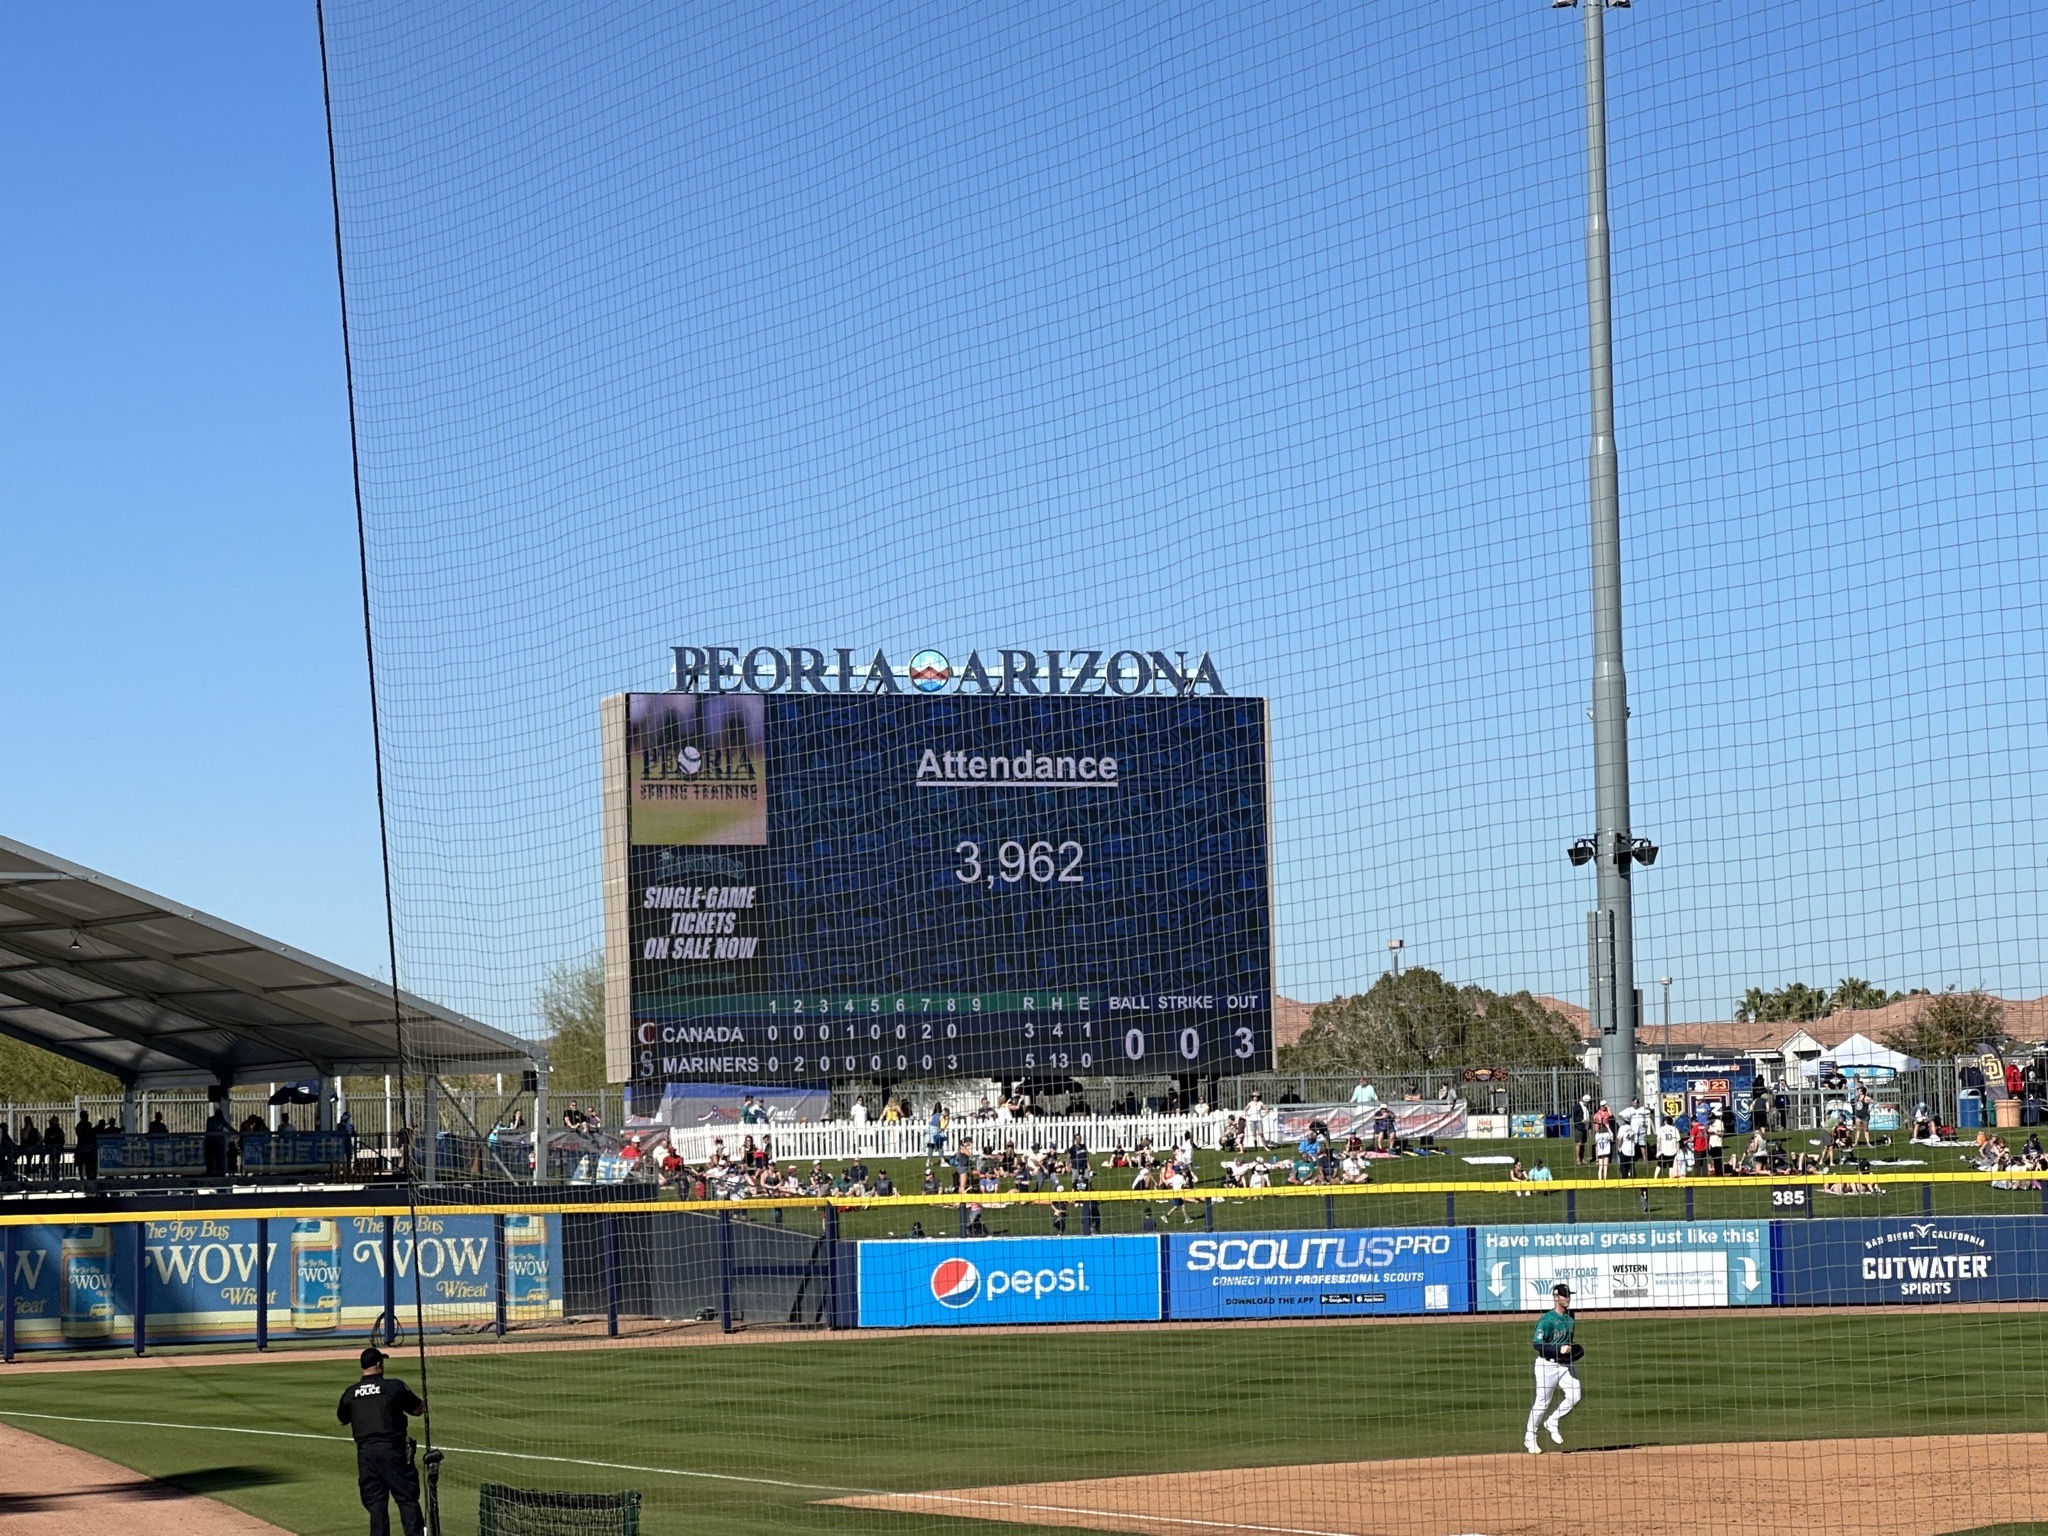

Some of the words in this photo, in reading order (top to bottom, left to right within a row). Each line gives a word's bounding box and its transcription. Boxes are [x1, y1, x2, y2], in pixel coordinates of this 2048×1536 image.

[670, 646, 902, 693] PEORIA
[953, 648, 1229, 696] ARIZONA
[916, 749, 1117, 779] Attendance
[955, 841, 1084, 889] 3,962
[644, 886, 757, 909] SINGLE-GAME
[670, 912, 737, 935] TICKETS
[643, 937, 670, 960] ON
[671, 937, 713, 960] SALE
[714, 937, 758, 960] NOW
[769, 1000, 777, 1014] 1
[794, 999, 803, 1013] 2
[820, 999, 829, 1013] 3
[845, 999, 854, 1013] 4
[871, 999, 880, 1012] 5
[896, 999, 905, 1012] 6
[921, 999, 930, 1012] 7
[947, 998, 956, 1012] 8
[972, 998, 981, 1012] 9
[1023, 997, 1034, 1011] R
[1052, 997, 1062, 1011] H
[1079, 997, 1089, 1010] E
[1109, 996, 1150, 1010] BALL
[1158, 996, 1213, 1010] STRIKE
[1227, 995, 1258, 1009] OUT
[662, 1026, 744, 1043] CANADA
[768, 1025, 778, 1041] 0
[793, 1025, 803, 1041] 0
[819, 1025, 829, 1040] 0
[846, 1025, 854, 1040] 1
[870, 1024, 881, 1040] 0
[896, 1024, 906, 1040] 0
[921, 1024, 931, 1039] 2
[947, 1023, 957, 1039] 0
[1024, 1023, 1035, 1038] 3
[1052, 1023, 1063, 1038] 4
[1083, 1022, 1091, 1037] 1
[1125, 1028, 1145, 1060] 0
[1180, 1028, 1200, 1060] 0
[1235, 1027, 1254, 1059] 3
[662, 1056, 759, 1073] MARINERS
[768, 1057, 778, 1073] 0
[794, 1056, 804, 1072] 2
[820, 1056, 830, 1072] 0
[845, 1056, 856, 1071] 0
[871, 1055, 881, 1071] 0
[897, 1055, 907, 1071] 0
[922, 1055, 932, 1070] 0
[947, 1054, 958, 1070] 3
[1025, 1054, 1035, 1069] 5
[1049, 1054, 1069, 1069] 13
[1081, 1053, 1092, 1068] 0
[1711, 1081, 1727, 1090] 23
[1772, 1190, 1805, 1206] 385
[169, 1221, 198, 1242] Joy
[200, 1220, 230, 1240] Bus
[416, 1216, 444, 1235] Bus
[1486, 1233, 1529, 1248] Have
[1534, 1231, 1595, 1247] natural
[1600, 1231, 1646, 1248] grass
[1650, 1229, 1684, 1247] just
[1687, 1228, 1719, 1244] like
[1723, 1228, 1760, 1243] this!
[1865, 1238, 1884, 1249] SAN
[1887, 1231, 1914, 1242] DIEGO
[1932, 1230, 1985, 1248] CALIFORNIA
[145, 1243, 277, 1285] WOW
[353, 1236, 488, 1278] WOW
[298, 1266, 341, 1282] WOW
[508, 1260, 549, 1276] WOW
[1555, 1268, 1574, 1277] WEST
[1575, 1267, 1598, 1277] COAST
[1613, 1264, 1648, 1273] WESTERN
[1862, 1255, 1988, 1280] CUTWATER
[69, 1274, 115, 1290] WOW
[987, 1262, 1084, 1301] pepsi
[1212, 1276, 1261, 1286] CONNECT
[1264, 1275, 1292, 1286] WITH
[1295, 1274, 1380, 1285] PROFESSIONAL
[1383, 1272, 1425, 1283] SCOUTS
[1613, 1273, 1649, 1289] SOD
[1901, 1282, 1951, 1295] SPIRITS
[437, 1280, 488, 1298] Wheat
[1225, 1297, 1275, 1305] DOWNLOAD
[1278, 1297, 1296, 1305] THE
[355, 1386, 380, 1397] POLICE
